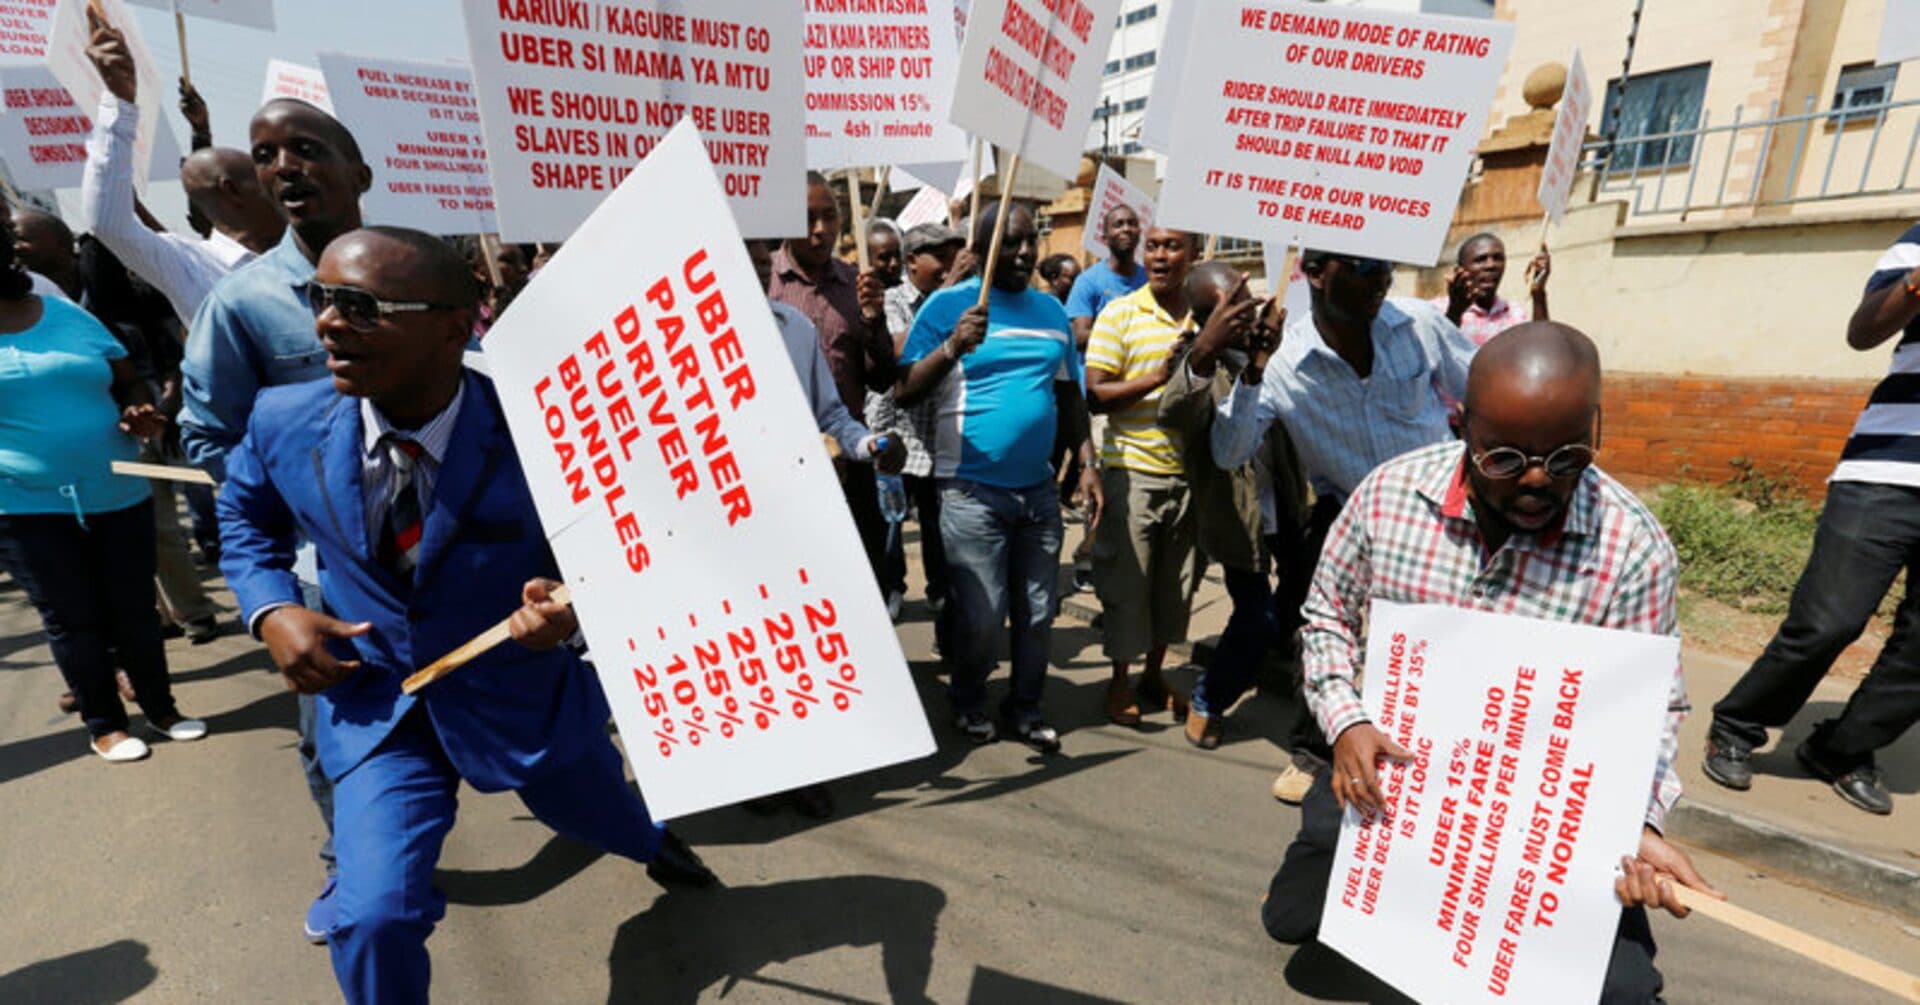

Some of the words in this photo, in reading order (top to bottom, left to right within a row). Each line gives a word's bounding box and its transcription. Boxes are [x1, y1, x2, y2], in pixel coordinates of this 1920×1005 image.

[497, 0, 589, 31] KARIUKI
[606, 6, 687, 43] KAGURE
[691, 18, 741, 49] MUST
[746, 27, 771, 54] GO
[1241, 9, 1266, 30] WE
[1270, 11, 1340, 39] DEMAND
[1344, 21, 1393, 46] MODE
[1396, 27, 1421, 48] OF
[1423, 31, 1489, 58] RATING
[501, 32, 574, 68] UBER
[582, 42, 606, 71] SI
[614, 47, 684, 79] MAMA
[691, 57, 719, 85] YA
[725, 62, 770, 91] MTU
[803, 54, 827, 79] UP
[831, 55, 855, 79] OR
[858, 55, 896, 79] SHIP
[900, 56, 933, 79] OUT
[1286, 43, 1309, 63] OF
[1312, 47, 1349, 68] OUR
[1351, 52, 1424, 79] DRIVERS
[507, 87, 544, 117] WE
[551, 91, 639, 125] SHOULD
[645, 101, 685, 128] NOT
[691, 104, 716, 132] BE
[722, 109, 770, 136] UBER
[805, 92, 895, 111] OMMISSION
[900, 93, 930, 112] 15%
[844, 119, 871, 137] 4sh
[883, 118, 933, 137] minute
[1224, 80, 1266, 101] RIDER
[1269, 86, 1326, 110] SHOULD
[1328, 94, 1365, 115] RATE
[1369, 101, 1465, 128] IMMEDIATELY
[515, 123, 601, 157] SLAVES
[606, 132, 629, 159] IN
[1226, 108, 1271, 128] AFTER
[1275, 113, 1306, 132] TRIP
[1308, 118, 1366, 142] FAILURE
[1370, 126, 1389, 145] TO
[1392, 129, 1431, 150] THAT
[1432, 135, 1449, 153] IT
[1236, 134, 1292, 156] SHOULD
[1294, 142, 1313, 160] BE
[1316, 146, 1350, 166] NULL
[1355, 151, 1386, 170] AND
[1389, 156, 1423, 176] VOID
[532, 161, 604, 190] SHAPE
[724, 173, 761, 198] OUT
[1206, 170, 1224, 185] IT
[1226, 173, 1244, 190] IS
[1248, 175, 1286, 196] TIME
[1290, 182, 1325, 201] FOR
[1327, 187, 1365, 207] OUR
[1369, 194, 1430, 217] VOICES
[1259, 200, 1279, 217] TO
[1282, 204, 1304, 222] BE
[1308, 209, 1365, 230] HEARD
[645, 276, 754, 528] PARTNER
[763, 612, 819, 719] 25%
[682, 248, 758, 411] UBER
[803, 598, 863, 713] 25%
[583, 330, 644, 462] FUEL
[694, 639, 744, 739] 25%
[613, 304, 700, 501] DRIVER
[727, 627, 780, 731] 25%
[533, 376, 592, 505] LOAN
[633, 663, 680, 758] 25%
[557, 353, 652, 574] BUNDLES
[664, 654, 710, 746] 10%
[1407, 639, 1428, 677] 35%
[1403, 682, 1420, 708] BY
[1504, 668, 1536, 750] MINUTE
[1553, 669, 1582, 730] BACK
[1342, 865, 1364, 907] FUEL
[1380, 632, 1407, 727] SHILLINGS
[1410, 737, 1433, 794] LOGIC
[1494, 754, 1518, 796] PER
[1539, 736, 1569, 798] COME
[1373, 760, 1408, 865] DECREASES
[1400, 820, 1416, 839] IS
[1405, 795, 1420, 817] IT
[1429, 796, 1458, 866] UBER
[1448, 739, 1470, 786] 15%
[1438, 813, 1478, 931] MINIMUM
[1467, 742, 1494, 807] FARE
[1482, 686, 1505, 733] 300
[1468, 800, 1507, 908] SHILLINGS
[1522, 802, 1552, 864] MUST
[1534, 891, 1560, 929] TO
[1547, 762, 1595, 886] NORMAL
[1361, 867, 1384, 915] UBER
[1504, 868, 1536, 936] FARES
[1453, 911, 1480, 967] FOUR
[1488, 938, 1517, 996] UBER
